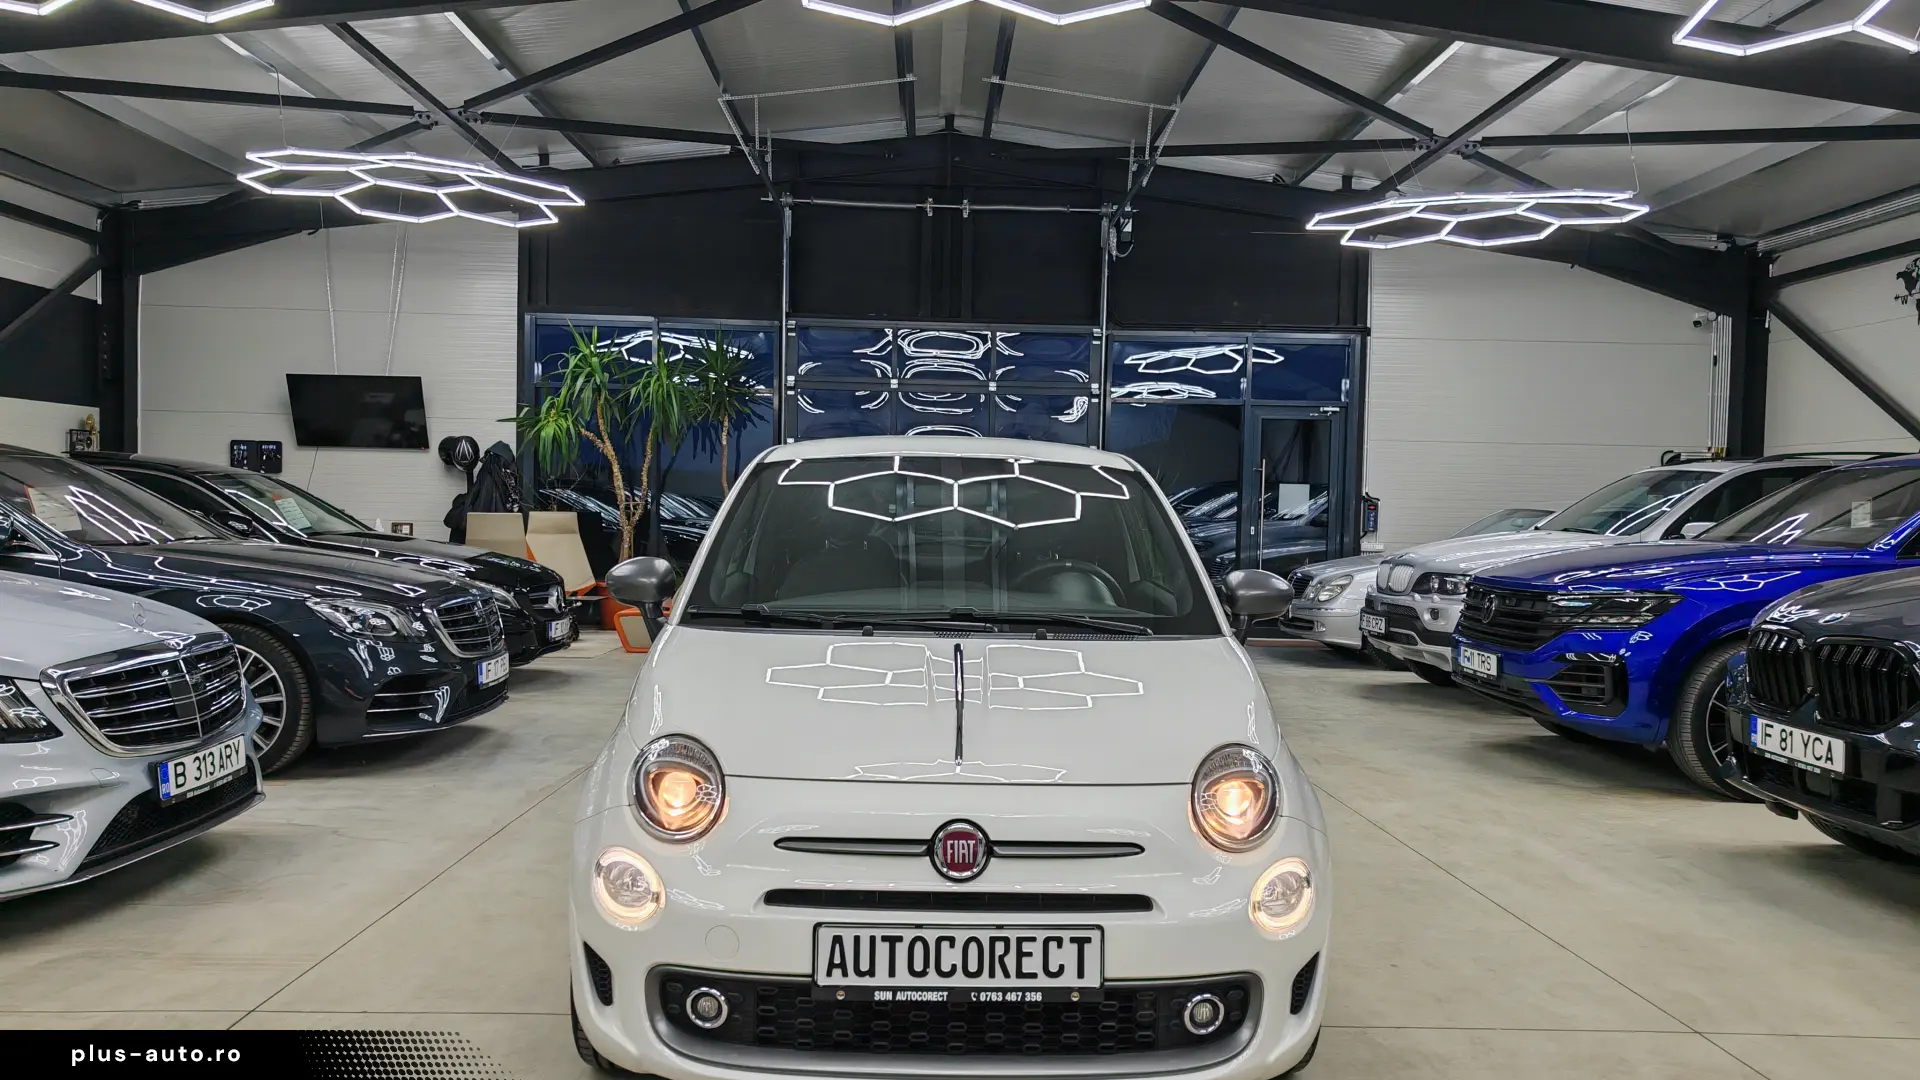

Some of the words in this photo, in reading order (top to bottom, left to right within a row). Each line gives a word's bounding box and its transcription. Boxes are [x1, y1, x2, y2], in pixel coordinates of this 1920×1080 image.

[1476, 652, 1492, 672] TRS
[1761, 721, 1774, 746] IF
[1779, 728, 1794, 754] 81
[1800, 732, 1835, 766] YCA
[174, 761, 187, 789] B
[193, 751, 216, 782] 313
[218, 739, 240, 773] ARY
[946, 839, 976, 865] FIAT
[825, 933, 1093, 980] AUTOCORECT
[874, 990, 893, 1001] SUN
[895, 991, 949, 1002] AUTOCORECT
[980, 991, 1003, 1002] 0763
[1005, 991, 1022, 1002] 467
[1025, 991, 1043, 1002] 356
